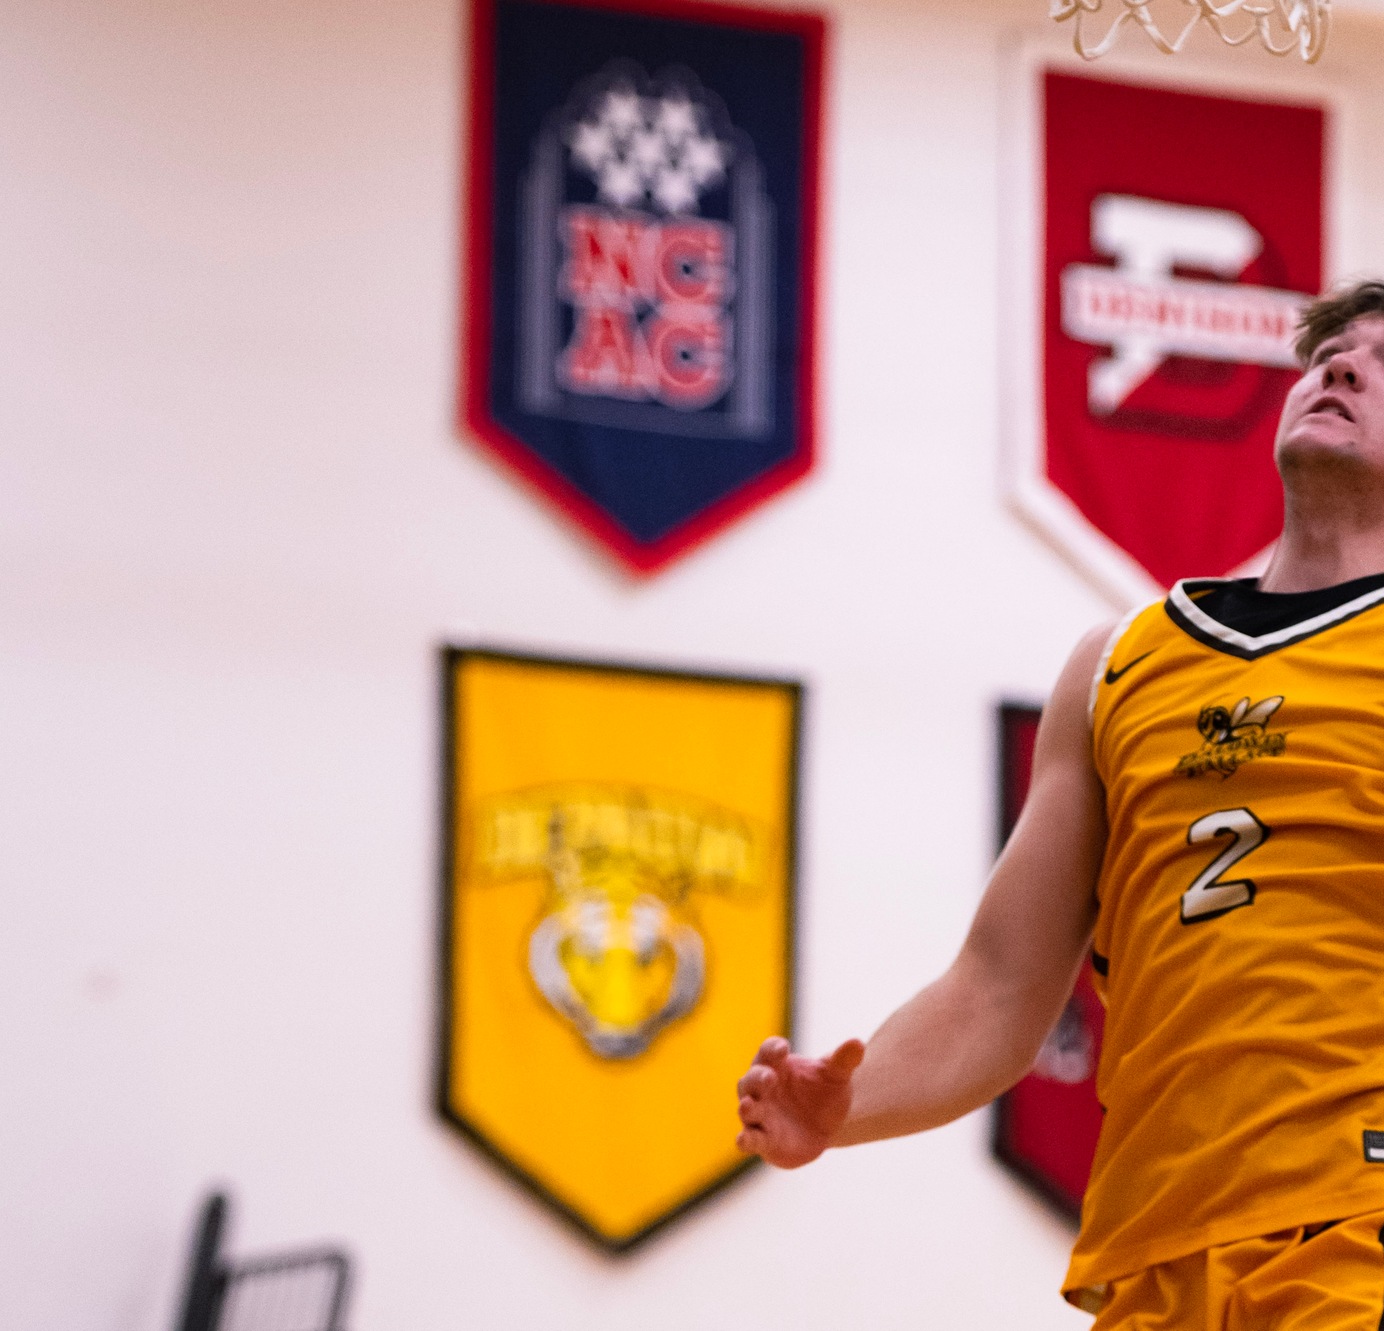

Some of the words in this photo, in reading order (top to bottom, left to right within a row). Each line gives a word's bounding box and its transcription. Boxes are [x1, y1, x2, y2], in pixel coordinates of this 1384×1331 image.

[567, 211, 729, 304] NC
[565, 306, 729, 402] AC
[1180, 806, 1272, 925] 2
